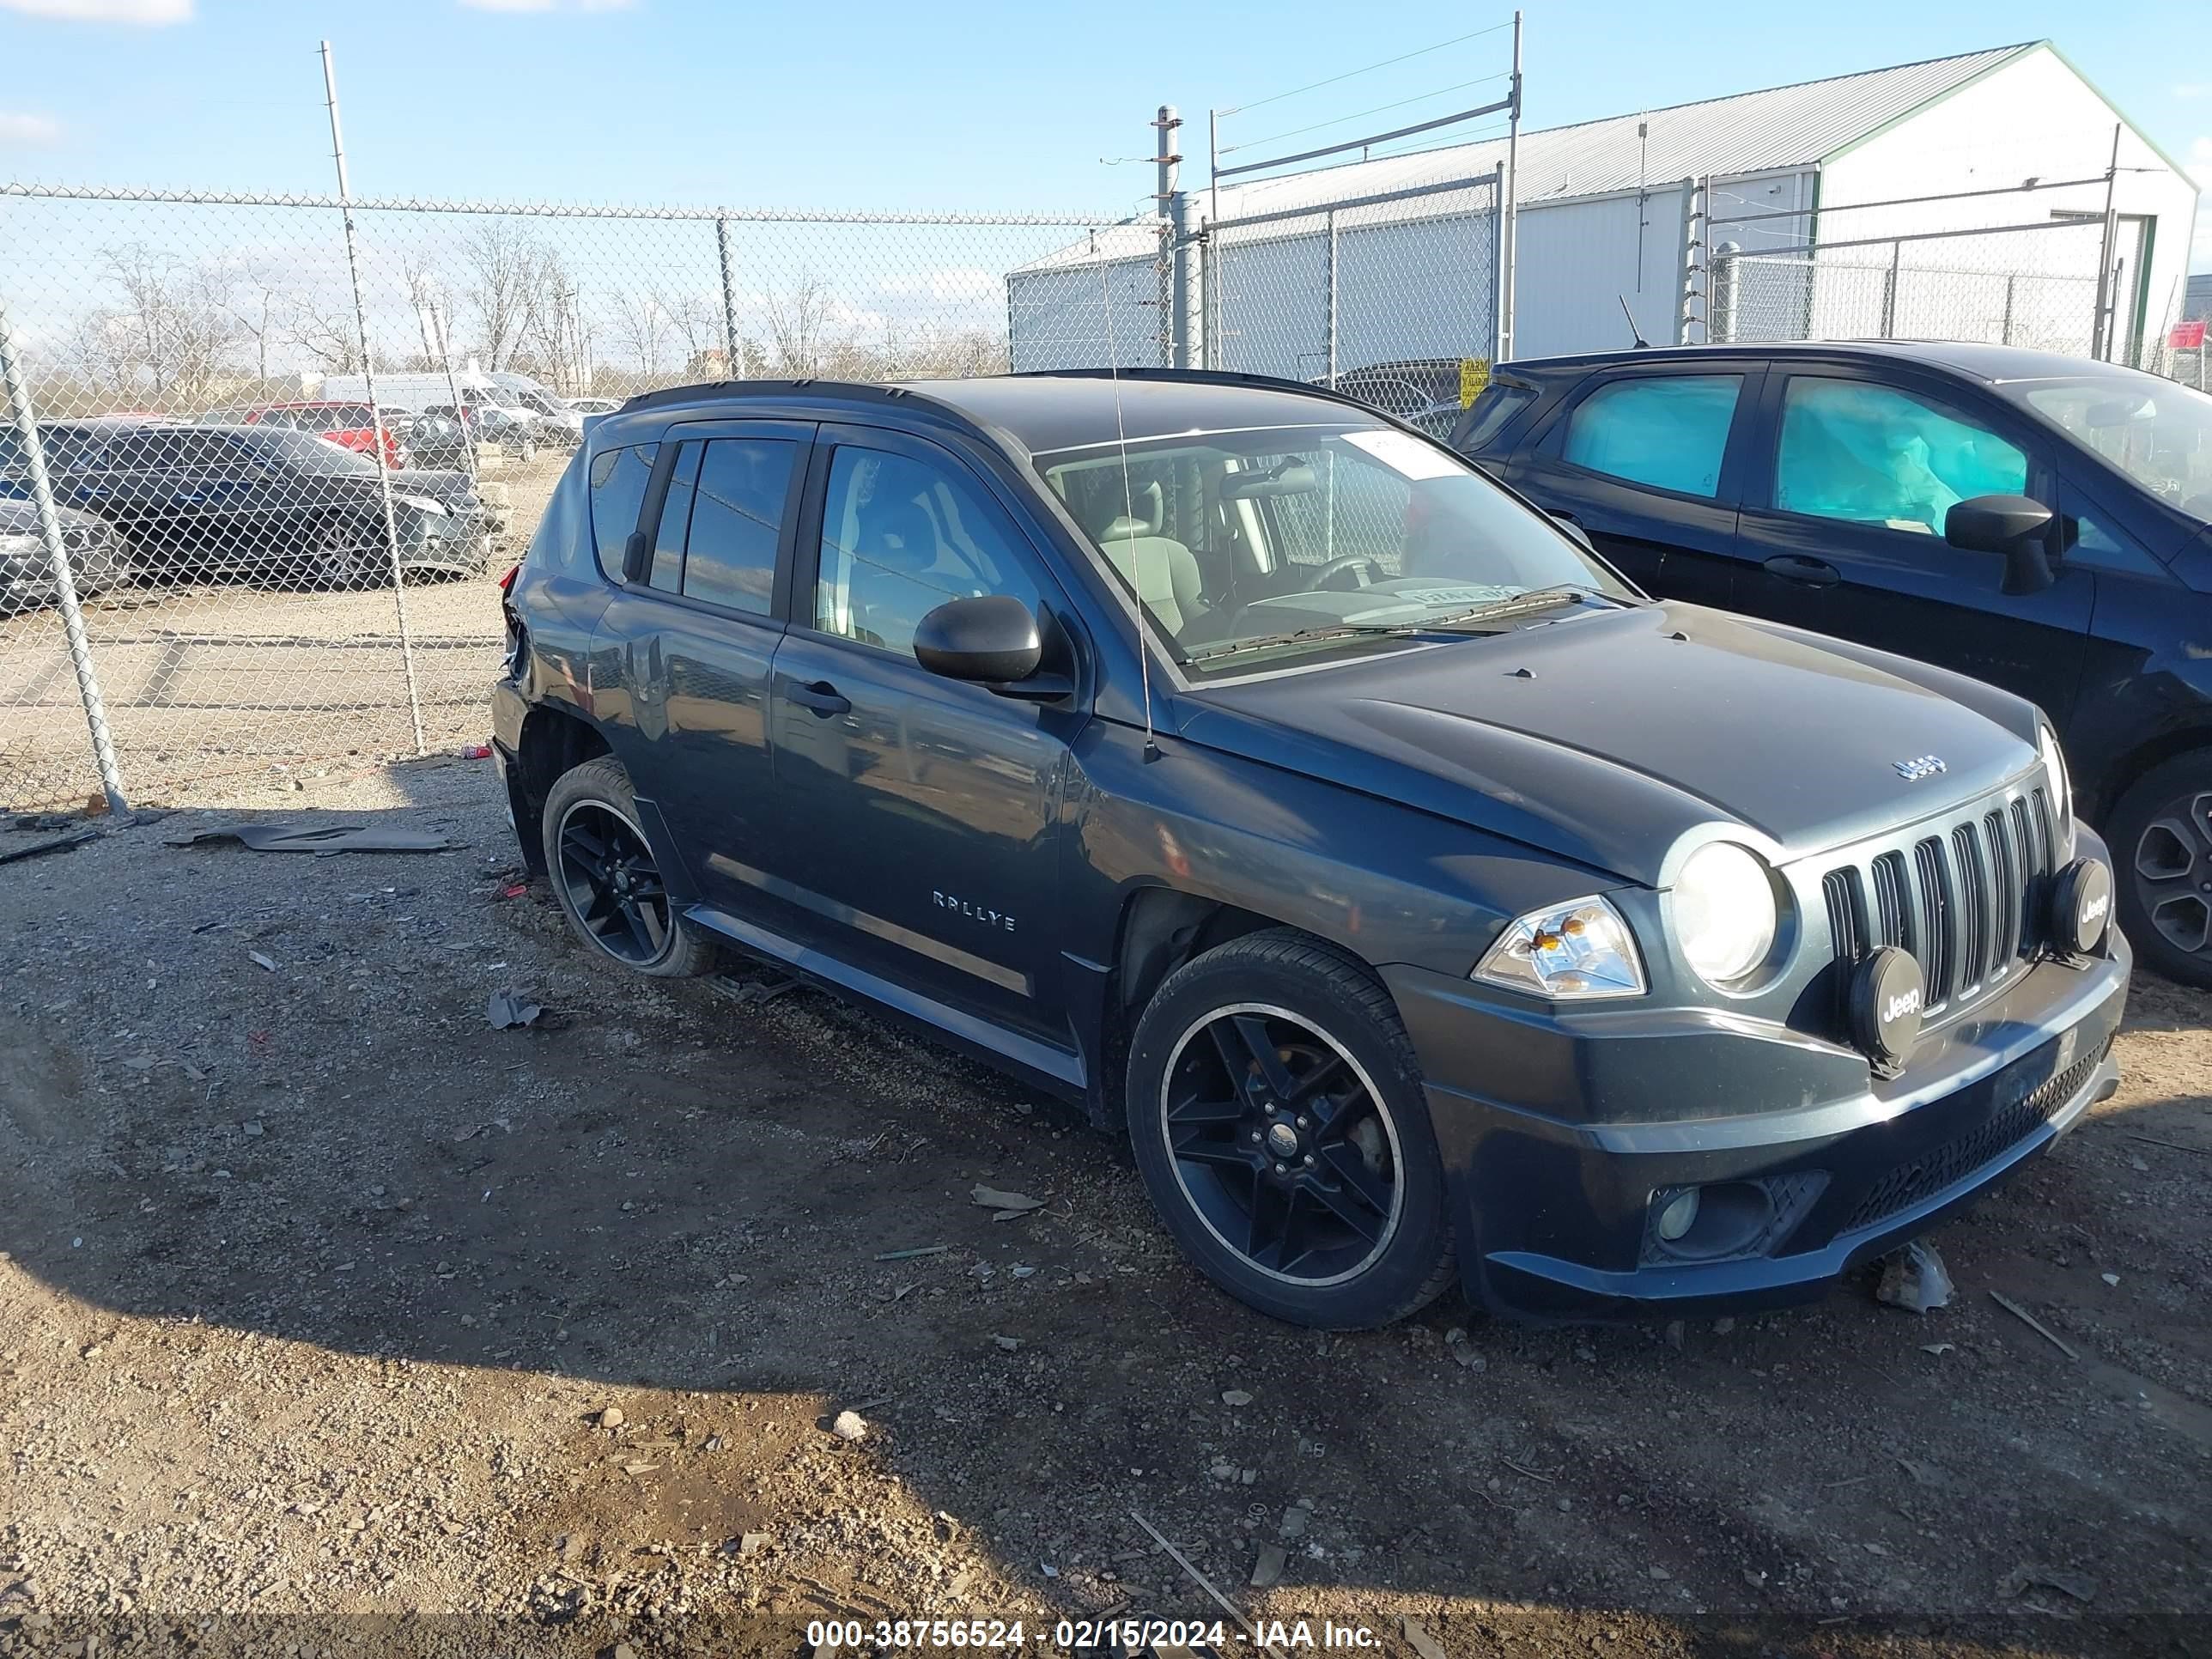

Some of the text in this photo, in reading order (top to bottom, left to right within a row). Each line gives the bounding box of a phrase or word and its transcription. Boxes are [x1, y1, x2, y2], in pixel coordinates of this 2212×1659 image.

[1892, 756, 1947, 780] Jeep
[933, 890, 1016, 932] RALLYE
[2082, 895, 2107, 924] Jeep
